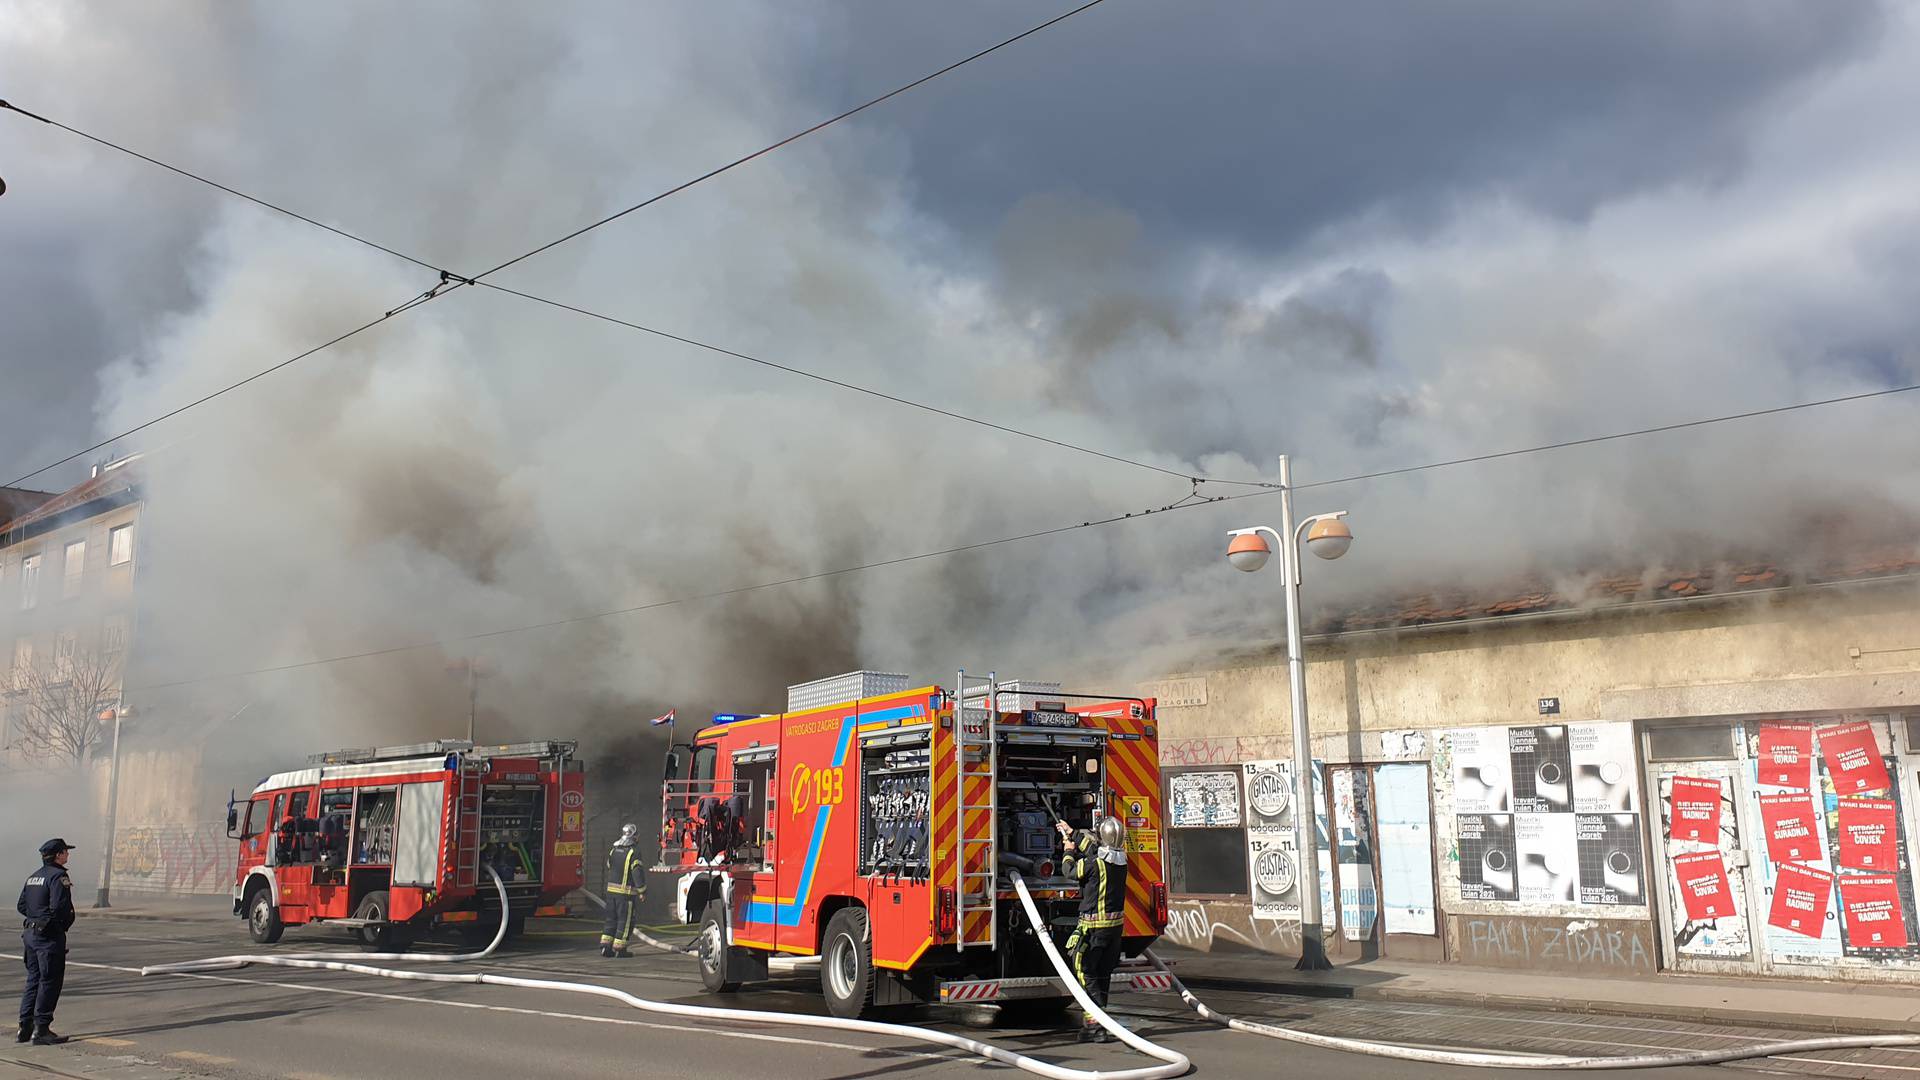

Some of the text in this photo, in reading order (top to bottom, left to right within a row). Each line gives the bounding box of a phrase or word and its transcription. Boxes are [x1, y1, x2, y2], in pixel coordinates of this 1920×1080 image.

[1540, 700, 1554, 708] 136
[786, 718, 839, 736] VATROGASCI ZAGREB
[1820, 731, 1836, 739] SVAKI
[1850, 724, 1868, 733] IZBOR
[1245, 763, 1288, 774] 13. 11.
[1841, 758, 1870, 771] RADNICI
[813, 768, 844, 804] 193
[1254, 776, 1284, 798] GUSTAFI
[566, 794, 580, 804] 193
[1458, 816, 1482, 824] Muzički
[1576, 816, 1602, 824] Muzički
[1682, 810, 1710, 820] RADNICA
[1250, 824, 1292, 834] boogaloo
[1774, 826, 1809, 840] SURADNJA
[1578, 832, 1602, 840] Zagreb
[1854, 832, 1881, 845] ČOVJEK
[1282, 840, 1294, 852] 11.
[1260, 852, 1290, 876] GUSTAFI
[1781, 864, 1830, 881] SVAKI DAN IZBOR
[1480, 891, 1496, 899] 2021
[1582, 894, 1618, 902] rujan 2021
[1256, 902, 1298, 912] boogaloo
[1786, 899, 1814, 912] RADNICI
[1858, 911, 1890, 922] RADNICA
[1543, 927, 1650, 968] ZIDARA
